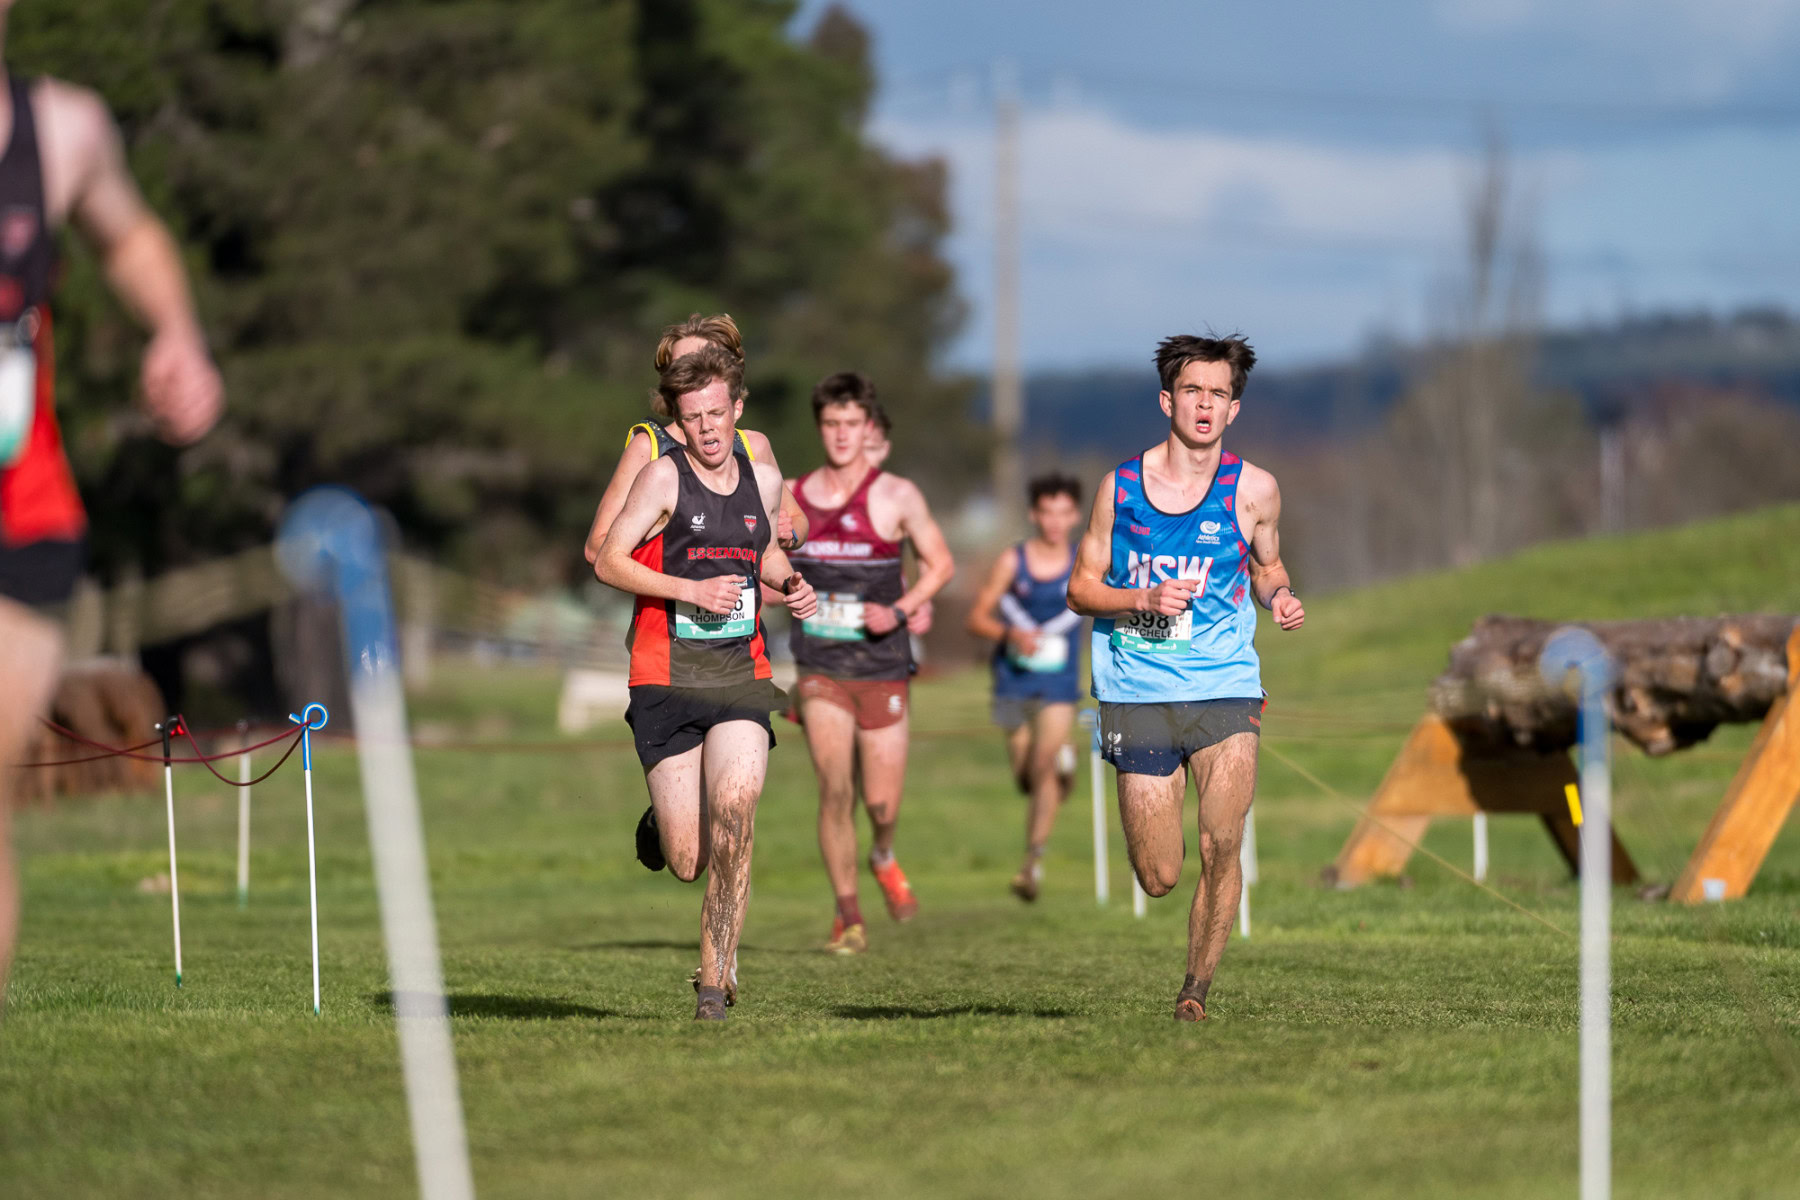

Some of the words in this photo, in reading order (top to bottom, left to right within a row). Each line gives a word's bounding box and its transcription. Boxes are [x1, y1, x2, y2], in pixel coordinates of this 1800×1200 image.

[1197, 533, 1220, 541] Athletics
[687, 547, 757, 564] ESSENDON
[1127, 550, 1214, 598] NSW
[689, 612, 745, 623] THOMPSON
[1124, 624, 1173, 639] MITCHELL
